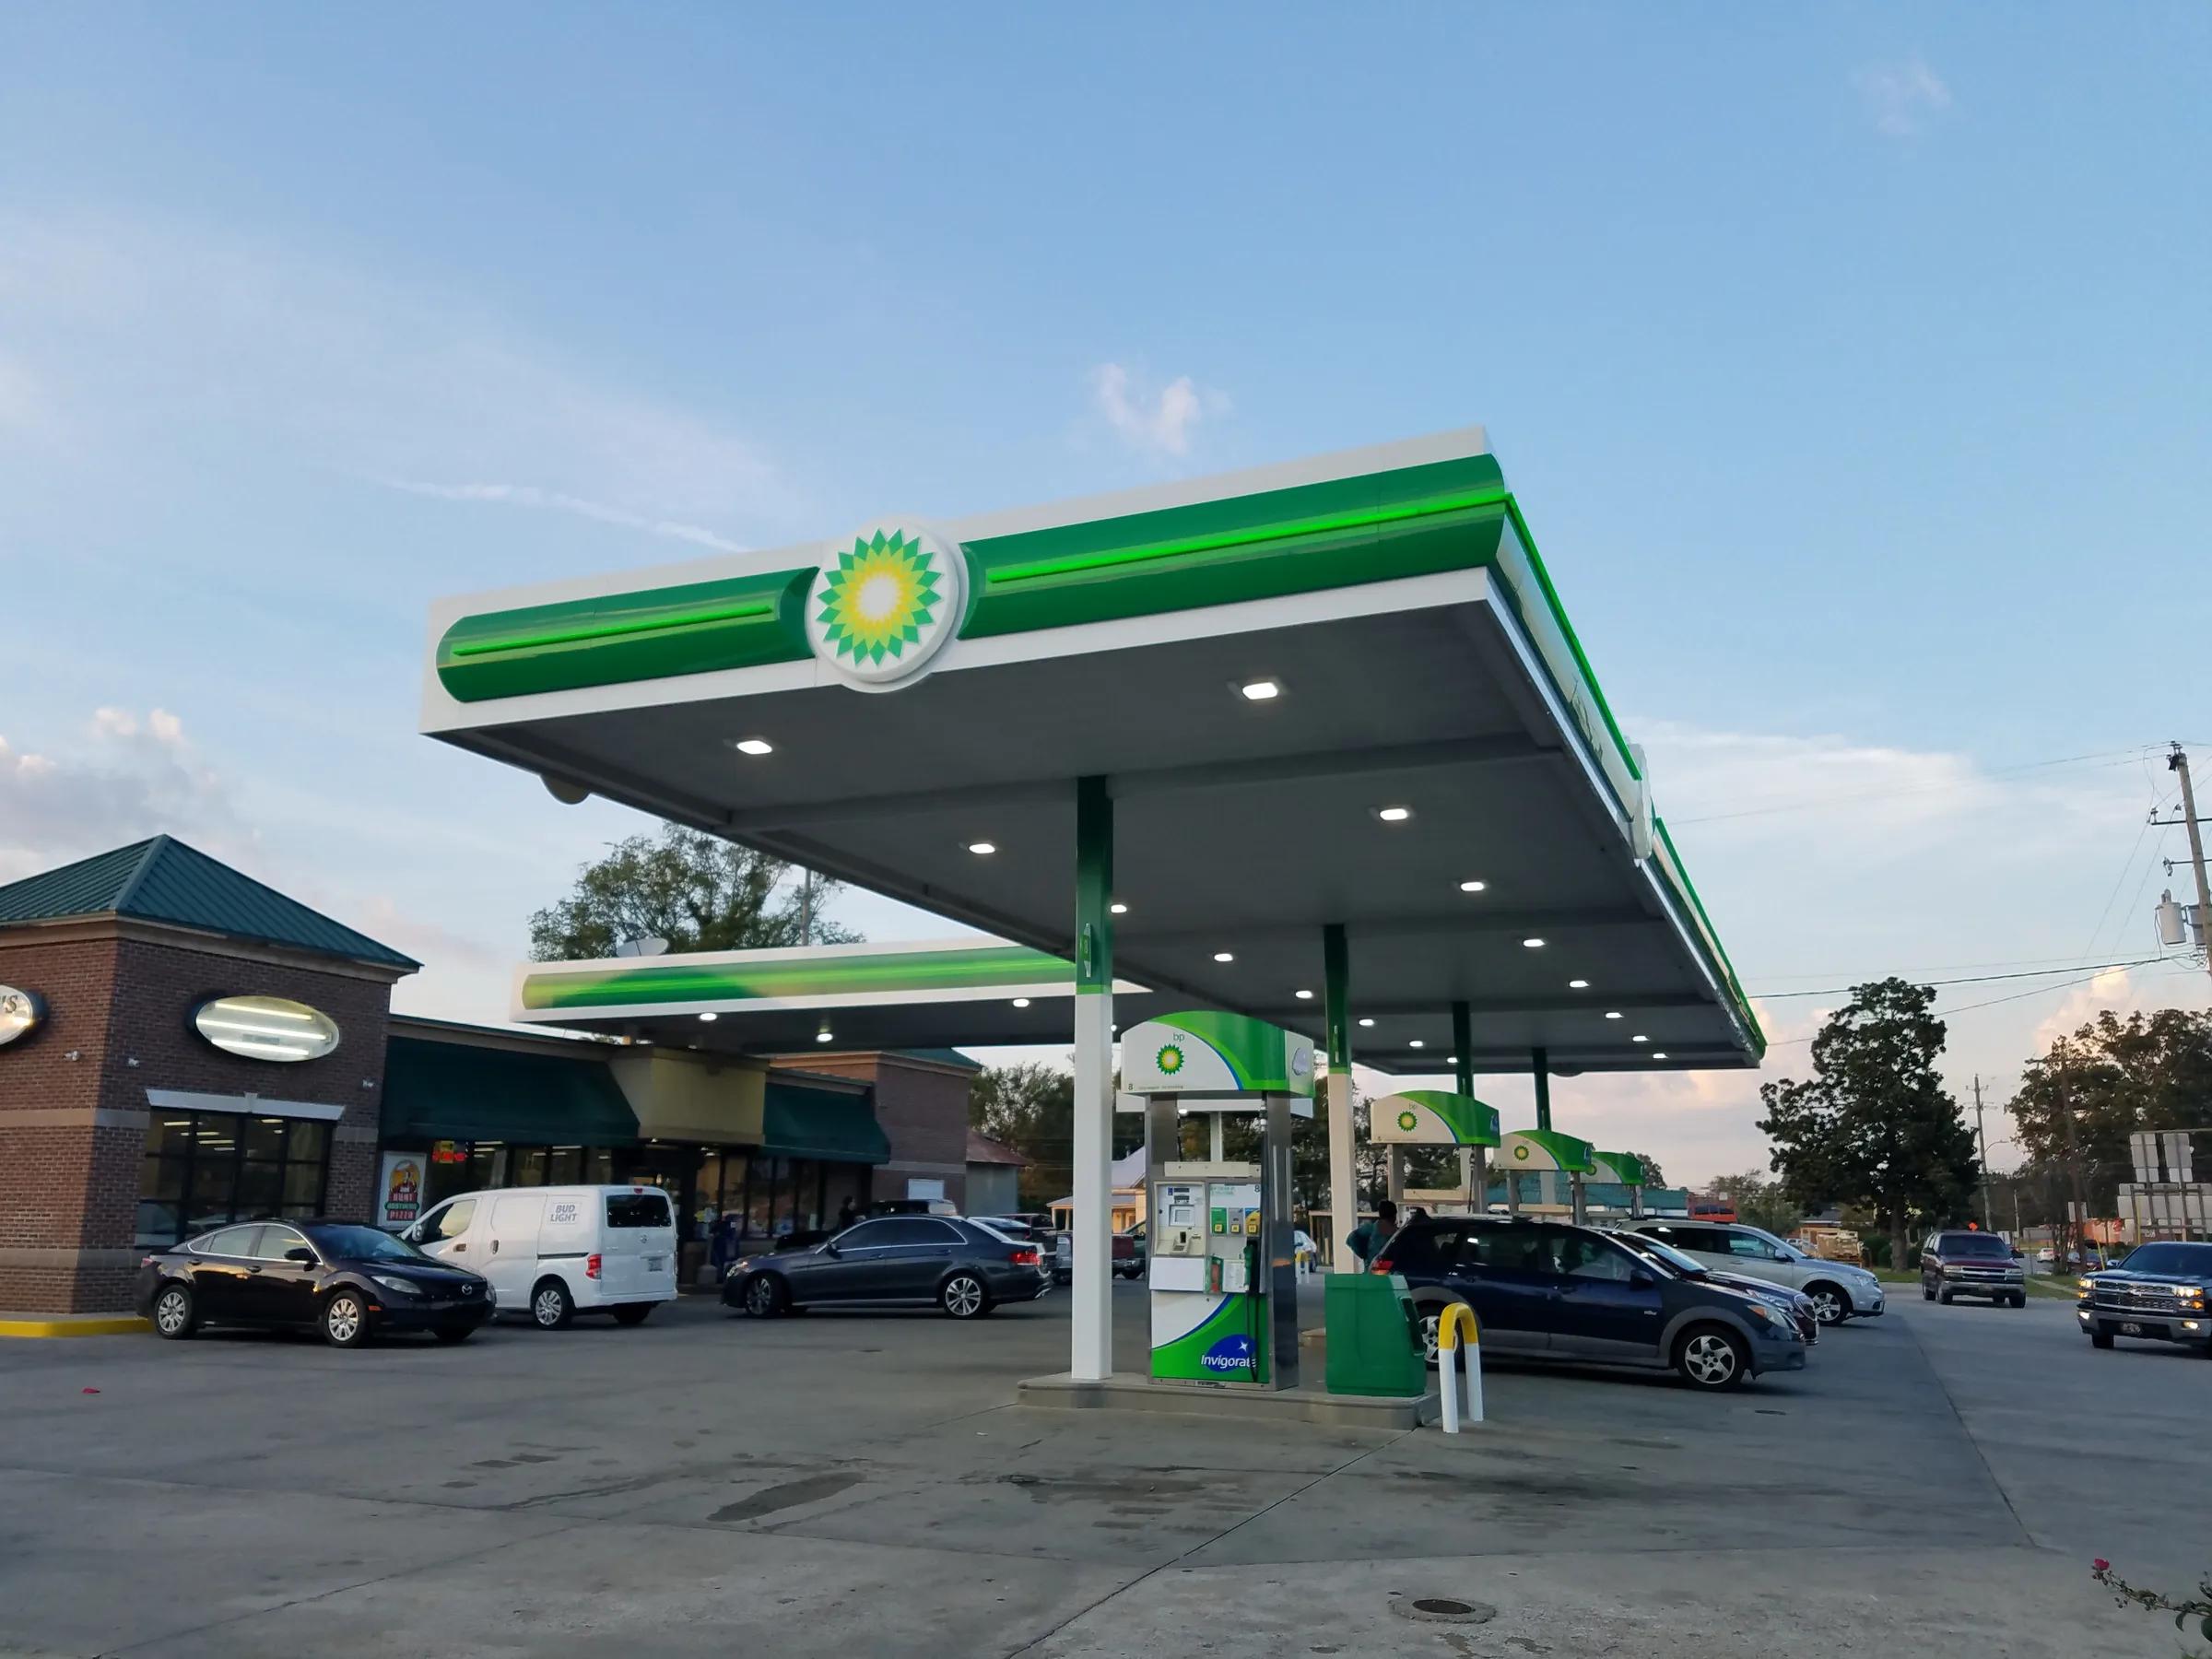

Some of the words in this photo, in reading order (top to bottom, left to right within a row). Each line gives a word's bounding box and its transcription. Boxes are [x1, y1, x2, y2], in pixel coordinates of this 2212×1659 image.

[1172, 1032, 1184, 1041] bp
[1254, 1184, 1260, 1193] 8
[556, 1205, 575, 1213] BUD
[550, 1213, 577, 1222] LIGHT
